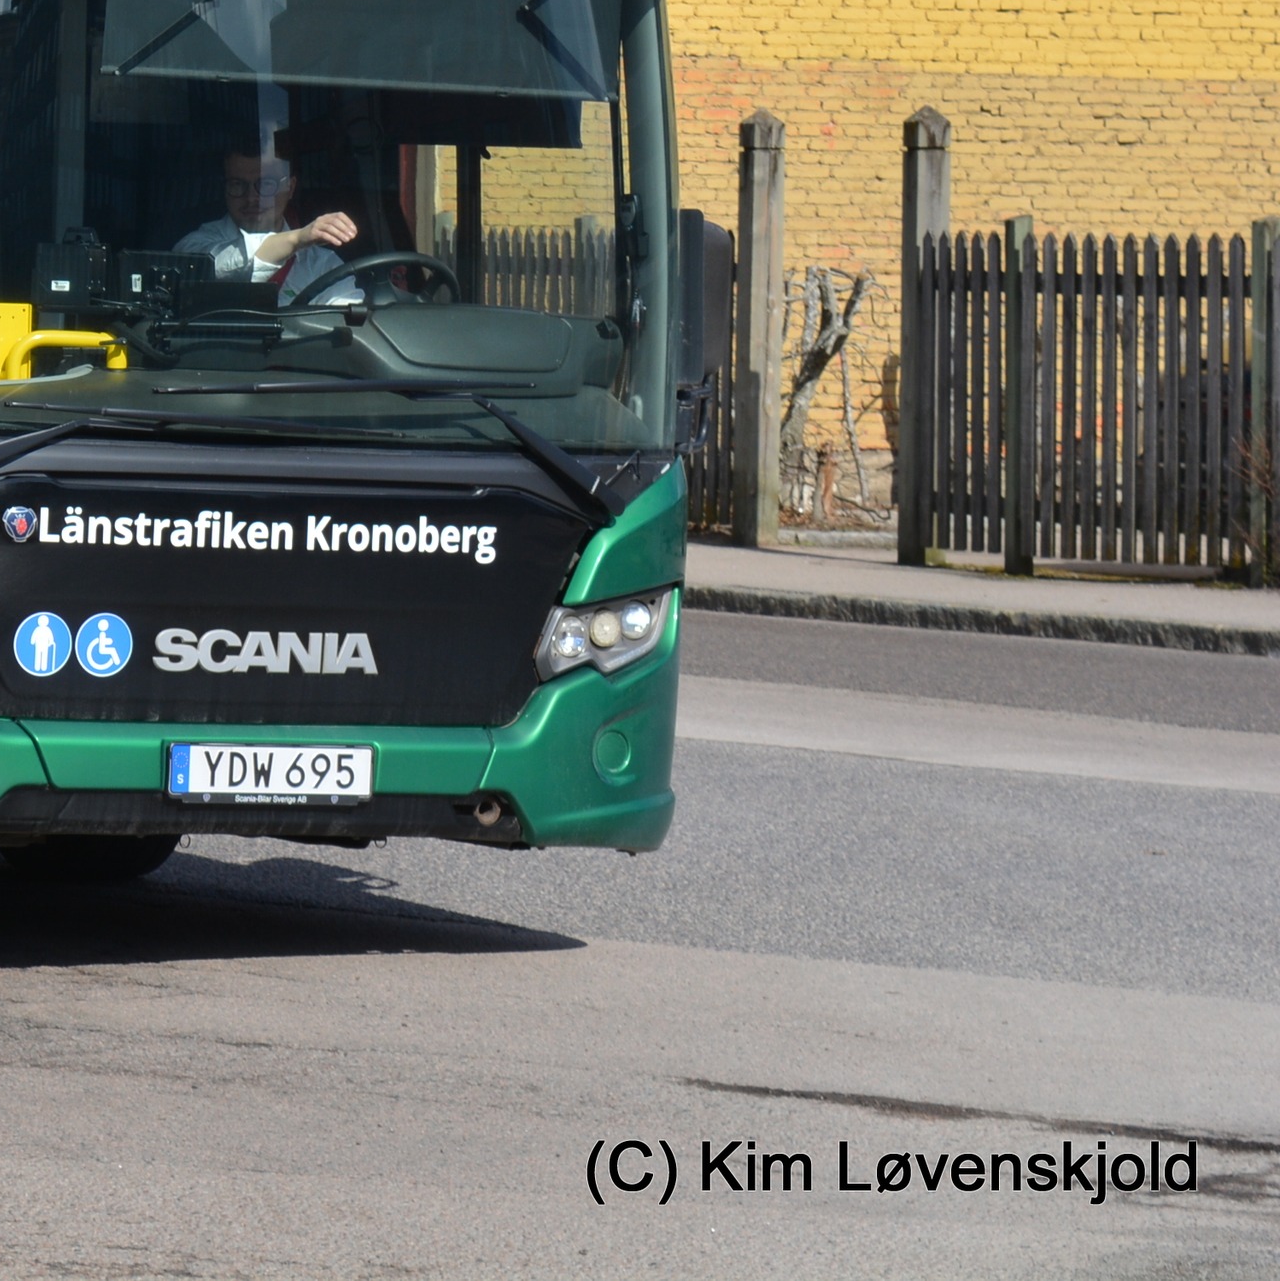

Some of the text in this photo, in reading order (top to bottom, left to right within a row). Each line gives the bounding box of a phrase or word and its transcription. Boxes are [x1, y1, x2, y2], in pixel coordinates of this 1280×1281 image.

[39, 505, 498, 565] Länstrafiken Kronoberg
[152, 627, 379, 675] SCANIA
[176, 750, 355, 790] S YDW 695
[234, 793, 308, 806] Scania-Bilar Sverige AB
